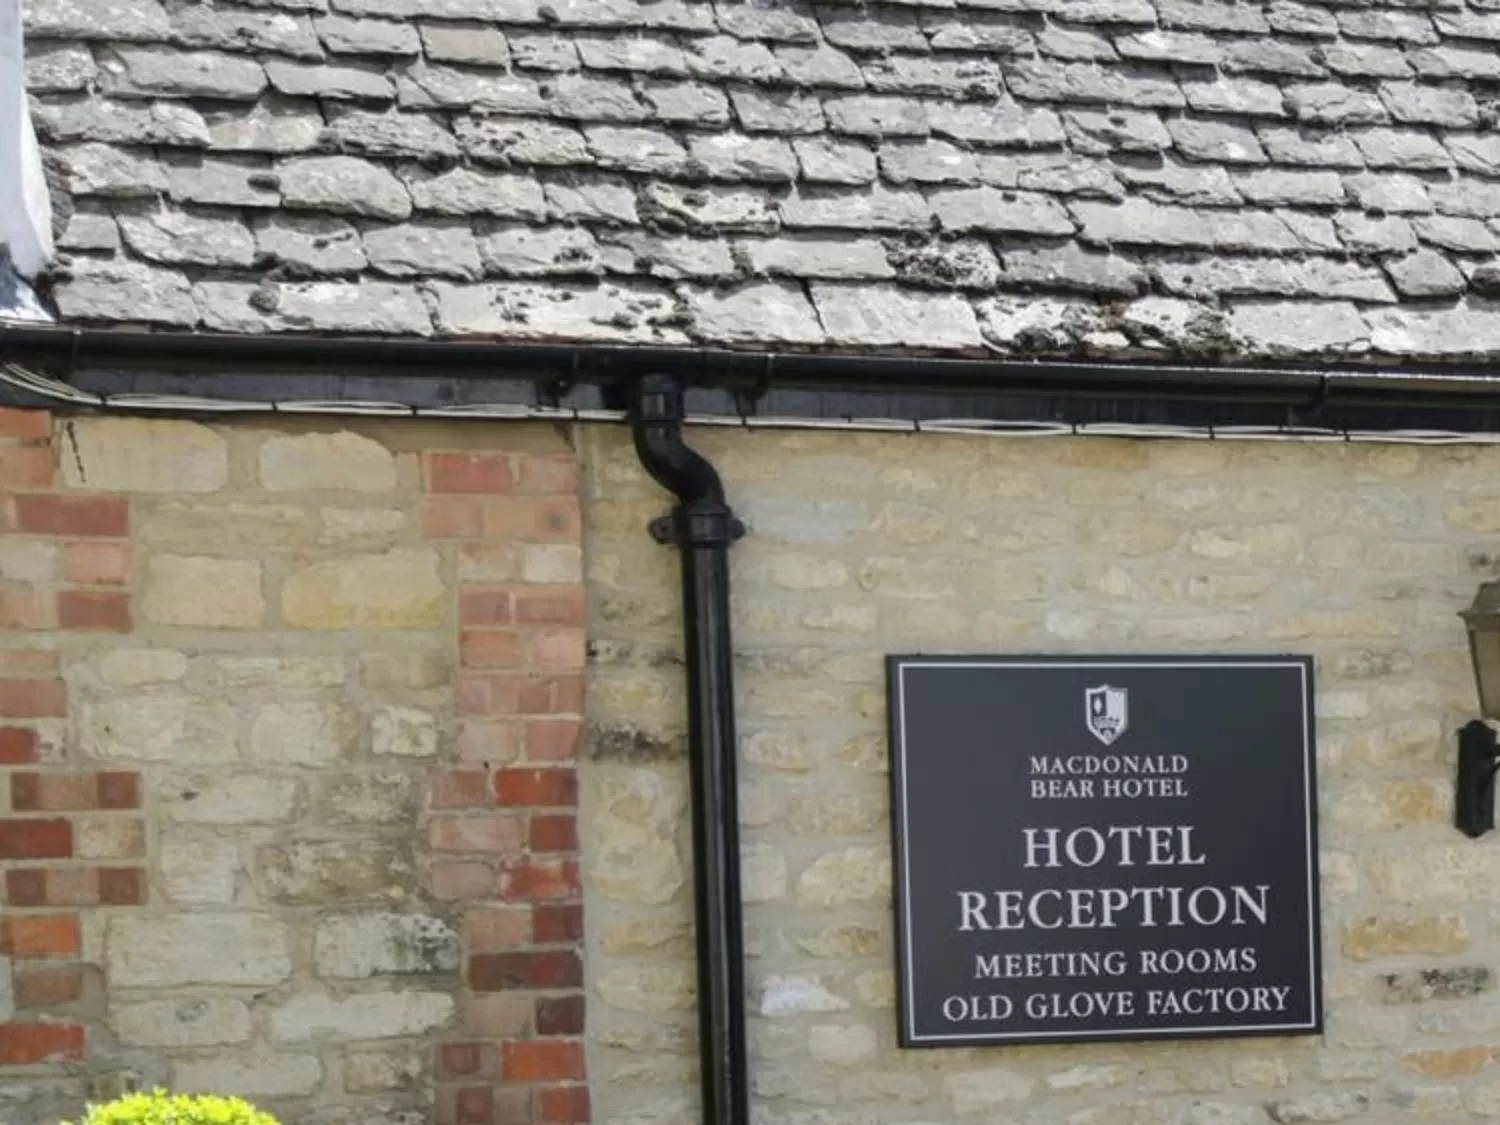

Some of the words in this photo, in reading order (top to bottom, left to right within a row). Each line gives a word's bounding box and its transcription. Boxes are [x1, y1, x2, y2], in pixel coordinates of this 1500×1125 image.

[1030, 755, 1188, 775] MACDONALD
[1031, 779, 1095, 799] BEAR
[1103, 778, 1188, 798] HOTEL
[1022, 825, 1206, 868] HOTEL
[957, 885, 1270, 931] RECEPTION
[975, 951, 1126, 979] MEETING
[1140, 947, 1257, 974] ROOMS
[942, 995, 1013, 1022] OLD
[1025, 991, 1135, 1019] GLOVE
[1147, 986, 1290, 1015] FACTORY
